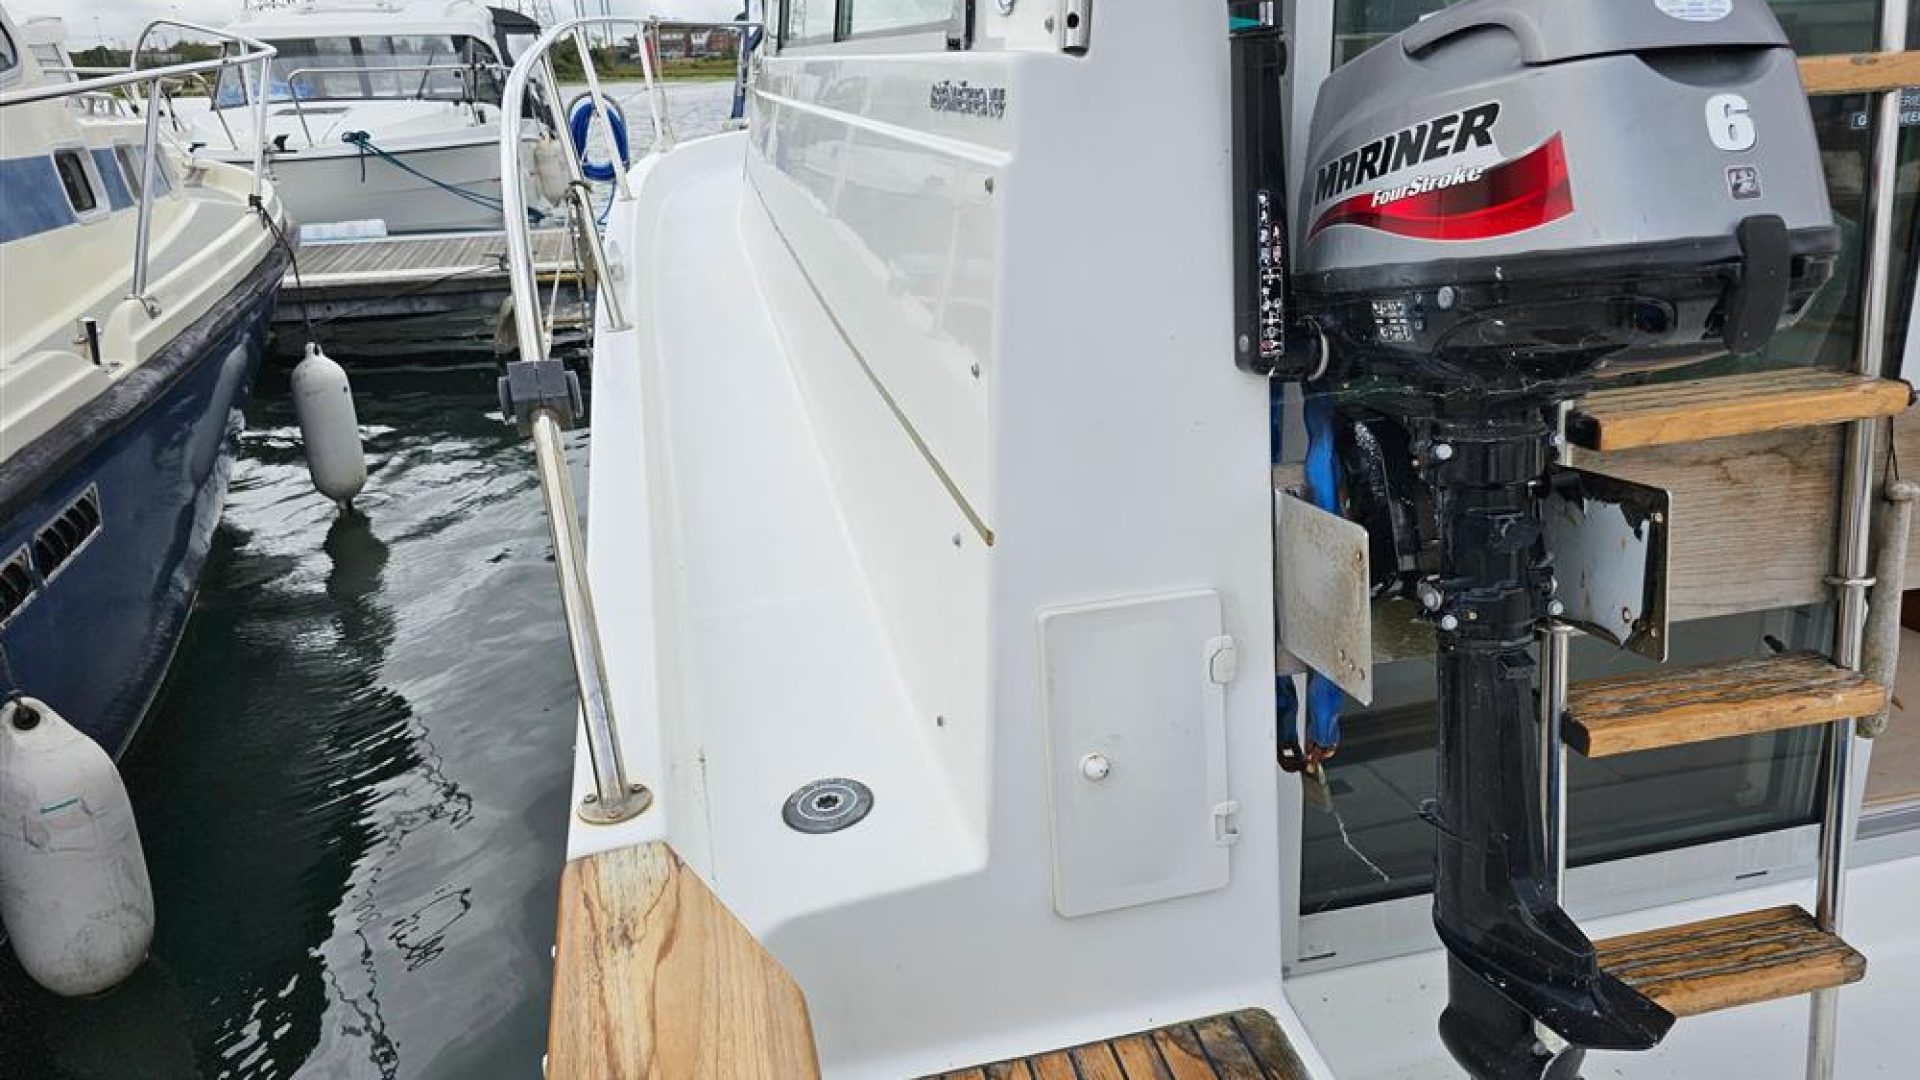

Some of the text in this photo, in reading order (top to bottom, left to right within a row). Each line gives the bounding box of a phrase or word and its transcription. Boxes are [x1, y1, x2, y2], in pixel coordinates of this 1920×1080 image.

[1705, 93, 1757, 151] 6
[1314, 102, 1500, 204] MARINER
[1371, 164, 1484, 207] FourStroke
